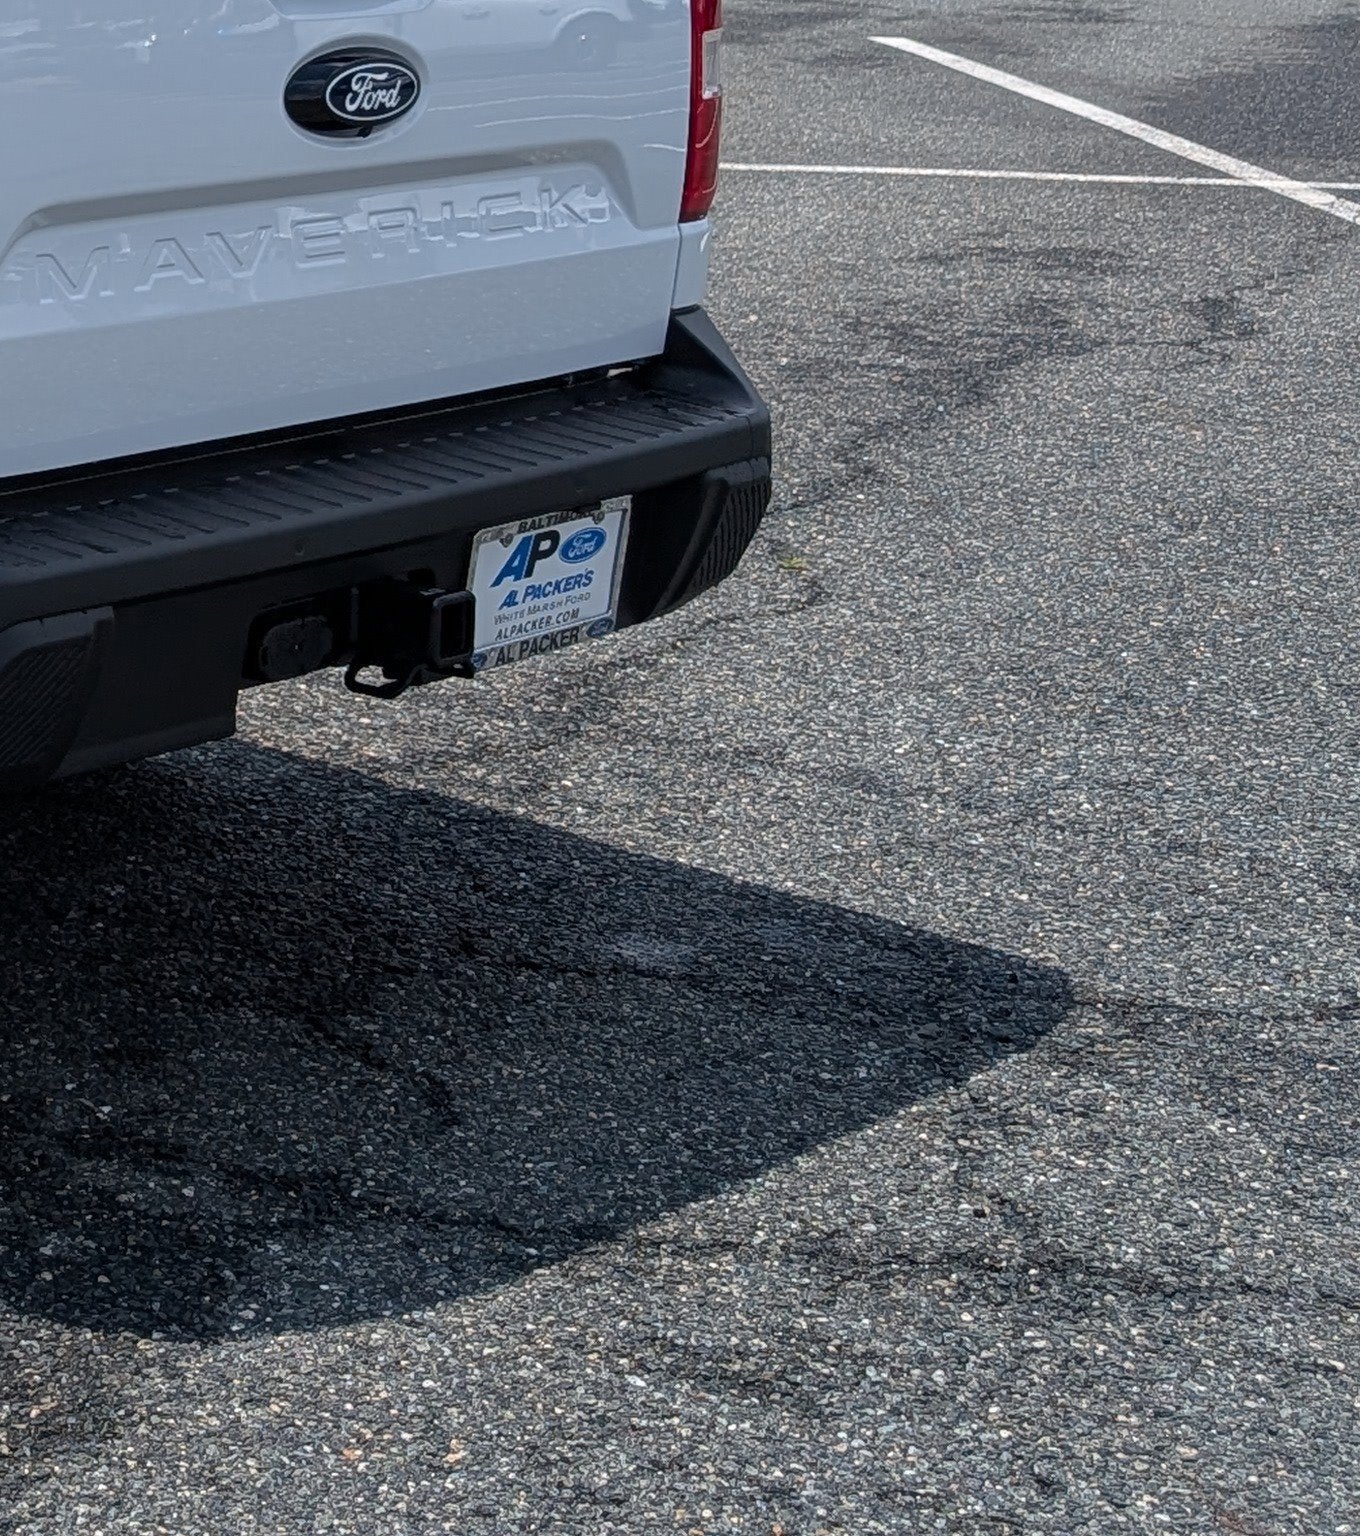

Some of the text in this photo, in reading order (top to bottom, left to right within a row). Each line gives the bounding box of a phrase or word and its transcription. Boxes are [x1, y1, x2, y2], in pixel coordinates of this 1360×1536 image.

[345, 71, 401, 112] Ford
[36, 184, 589, 305] MAVERICK
[490, 529, 561, 588] AP
[498, 568, 595, 611] AL PACKER'S
[495, 607, 580, 641] ALPACKER.COM
[495, 645, 515, 665] AL
[519, 626, 580, 660] PACKER
